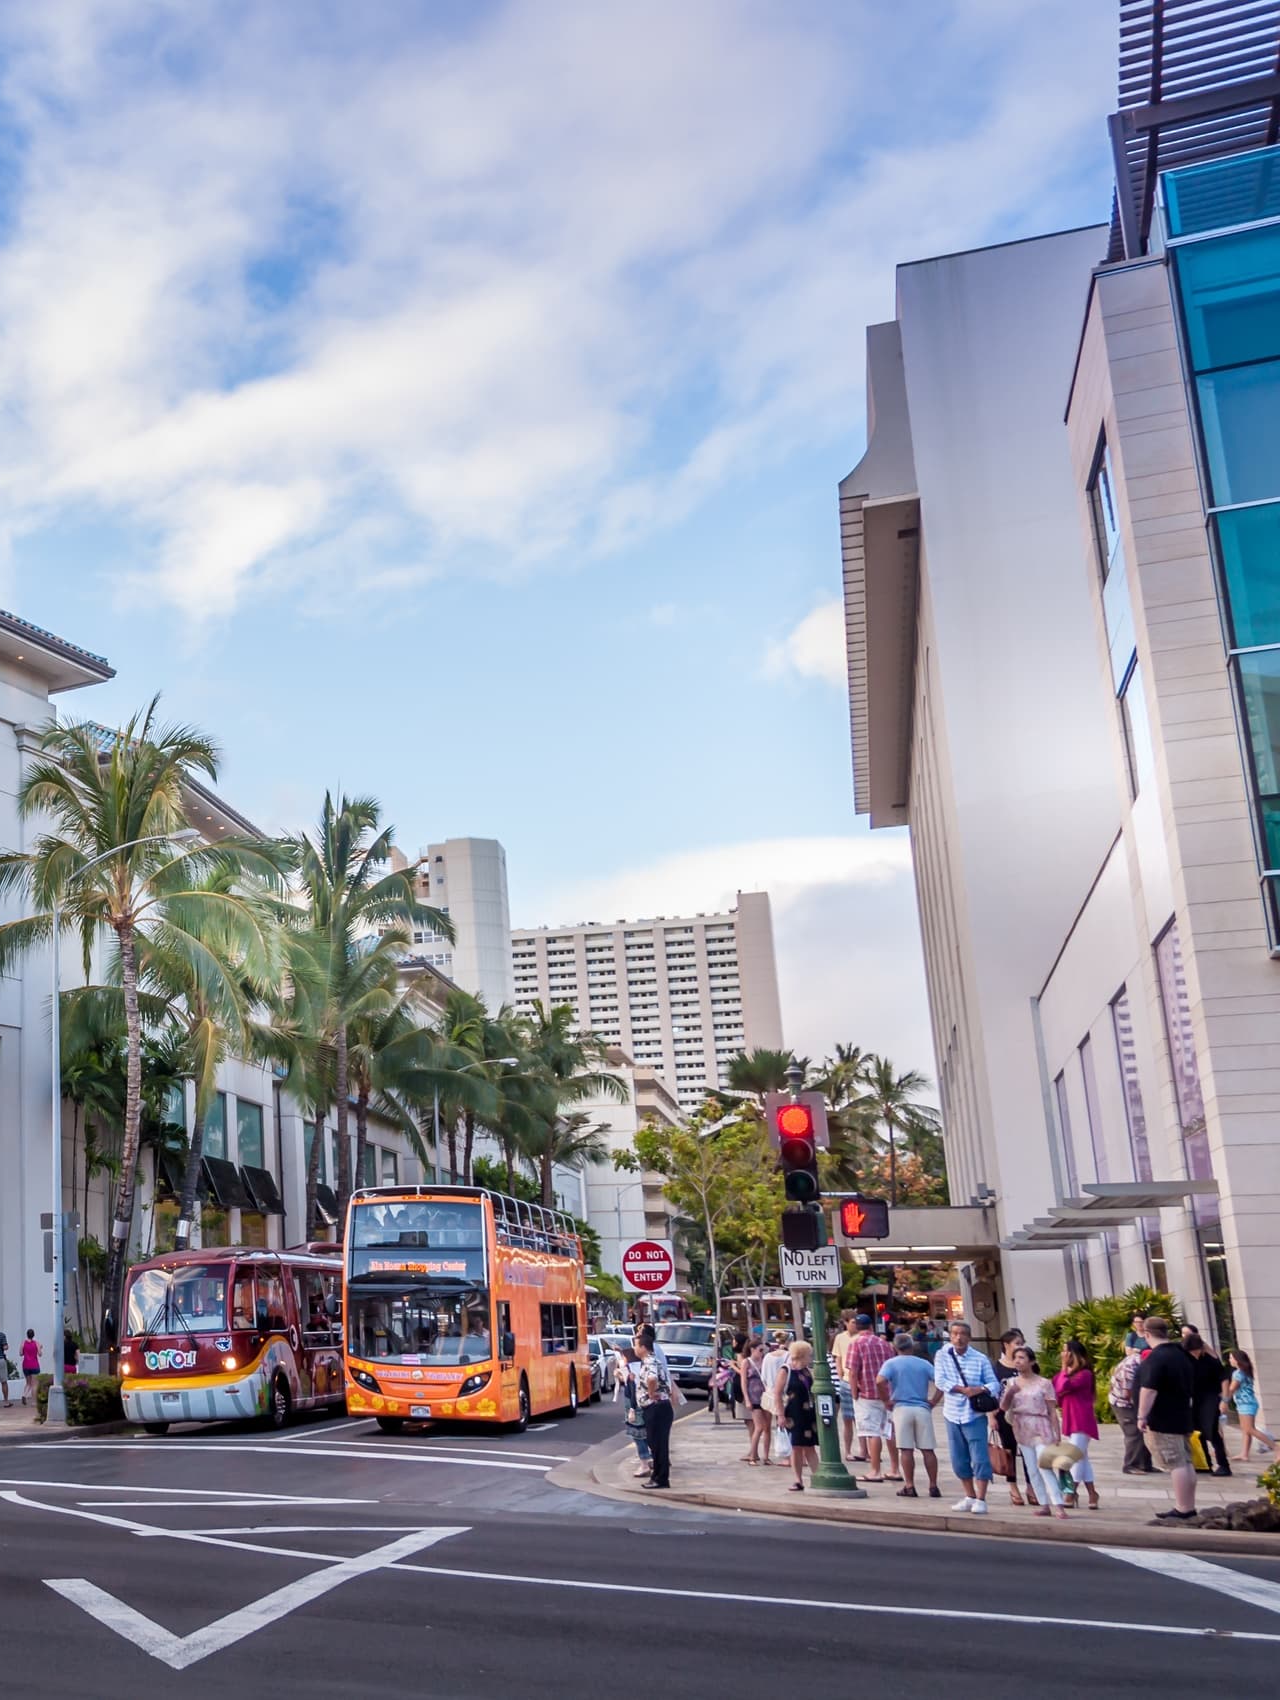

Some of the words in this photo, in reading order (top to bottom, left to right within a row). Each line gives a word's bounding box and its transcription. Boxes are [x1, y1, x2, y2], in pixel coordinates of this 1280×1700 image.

[628, 1251, 642, 1260] DO
[646, 1250, 664, 1259] NOT
[784, 1251, 804, 1266] NO
[807, 1255, 835, 1266] LEFT
[408, 1261, 441, 1273] Shopping
[633, 1272, 663, 1282] ENTER
[796, 1270, 827, 1281] TURN
